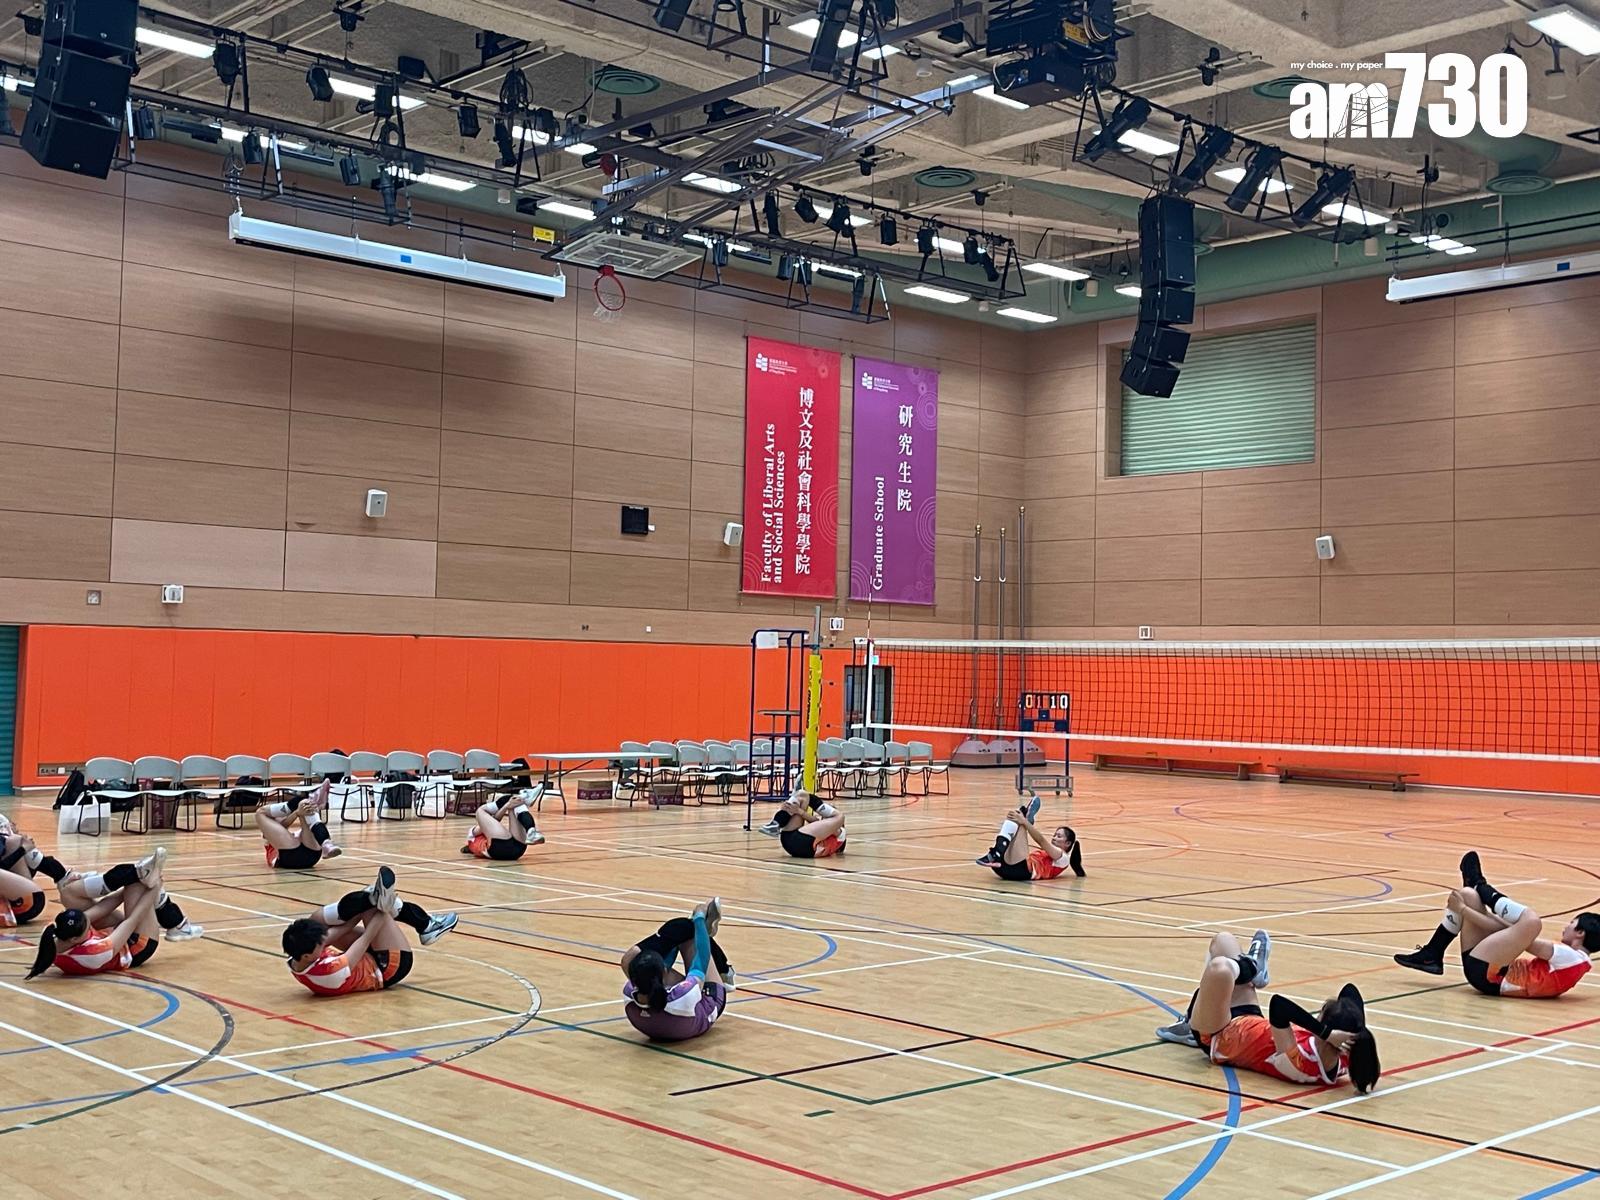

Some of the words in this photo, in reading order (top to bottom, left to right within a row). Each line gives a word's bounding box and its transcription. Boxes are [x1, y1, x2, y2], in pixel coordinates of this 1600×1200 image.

[764, 423, 775, 456] Arts
[897, 404, 914, 512] 研究生院
[763, 457, 774, 510] Liberal
[774, 451, 785, 510] Sciences
[795, 386, 814, 575] 博文及社會科學學院
[874, 476, 885, 522] School
[762, 511, 773, 527] of
[772, 512, 784, 554] Social
[761, 531, 775, 582] Faculty
[772, 558, 783, 584] and
[872, 525, 884, 590] Graduate
